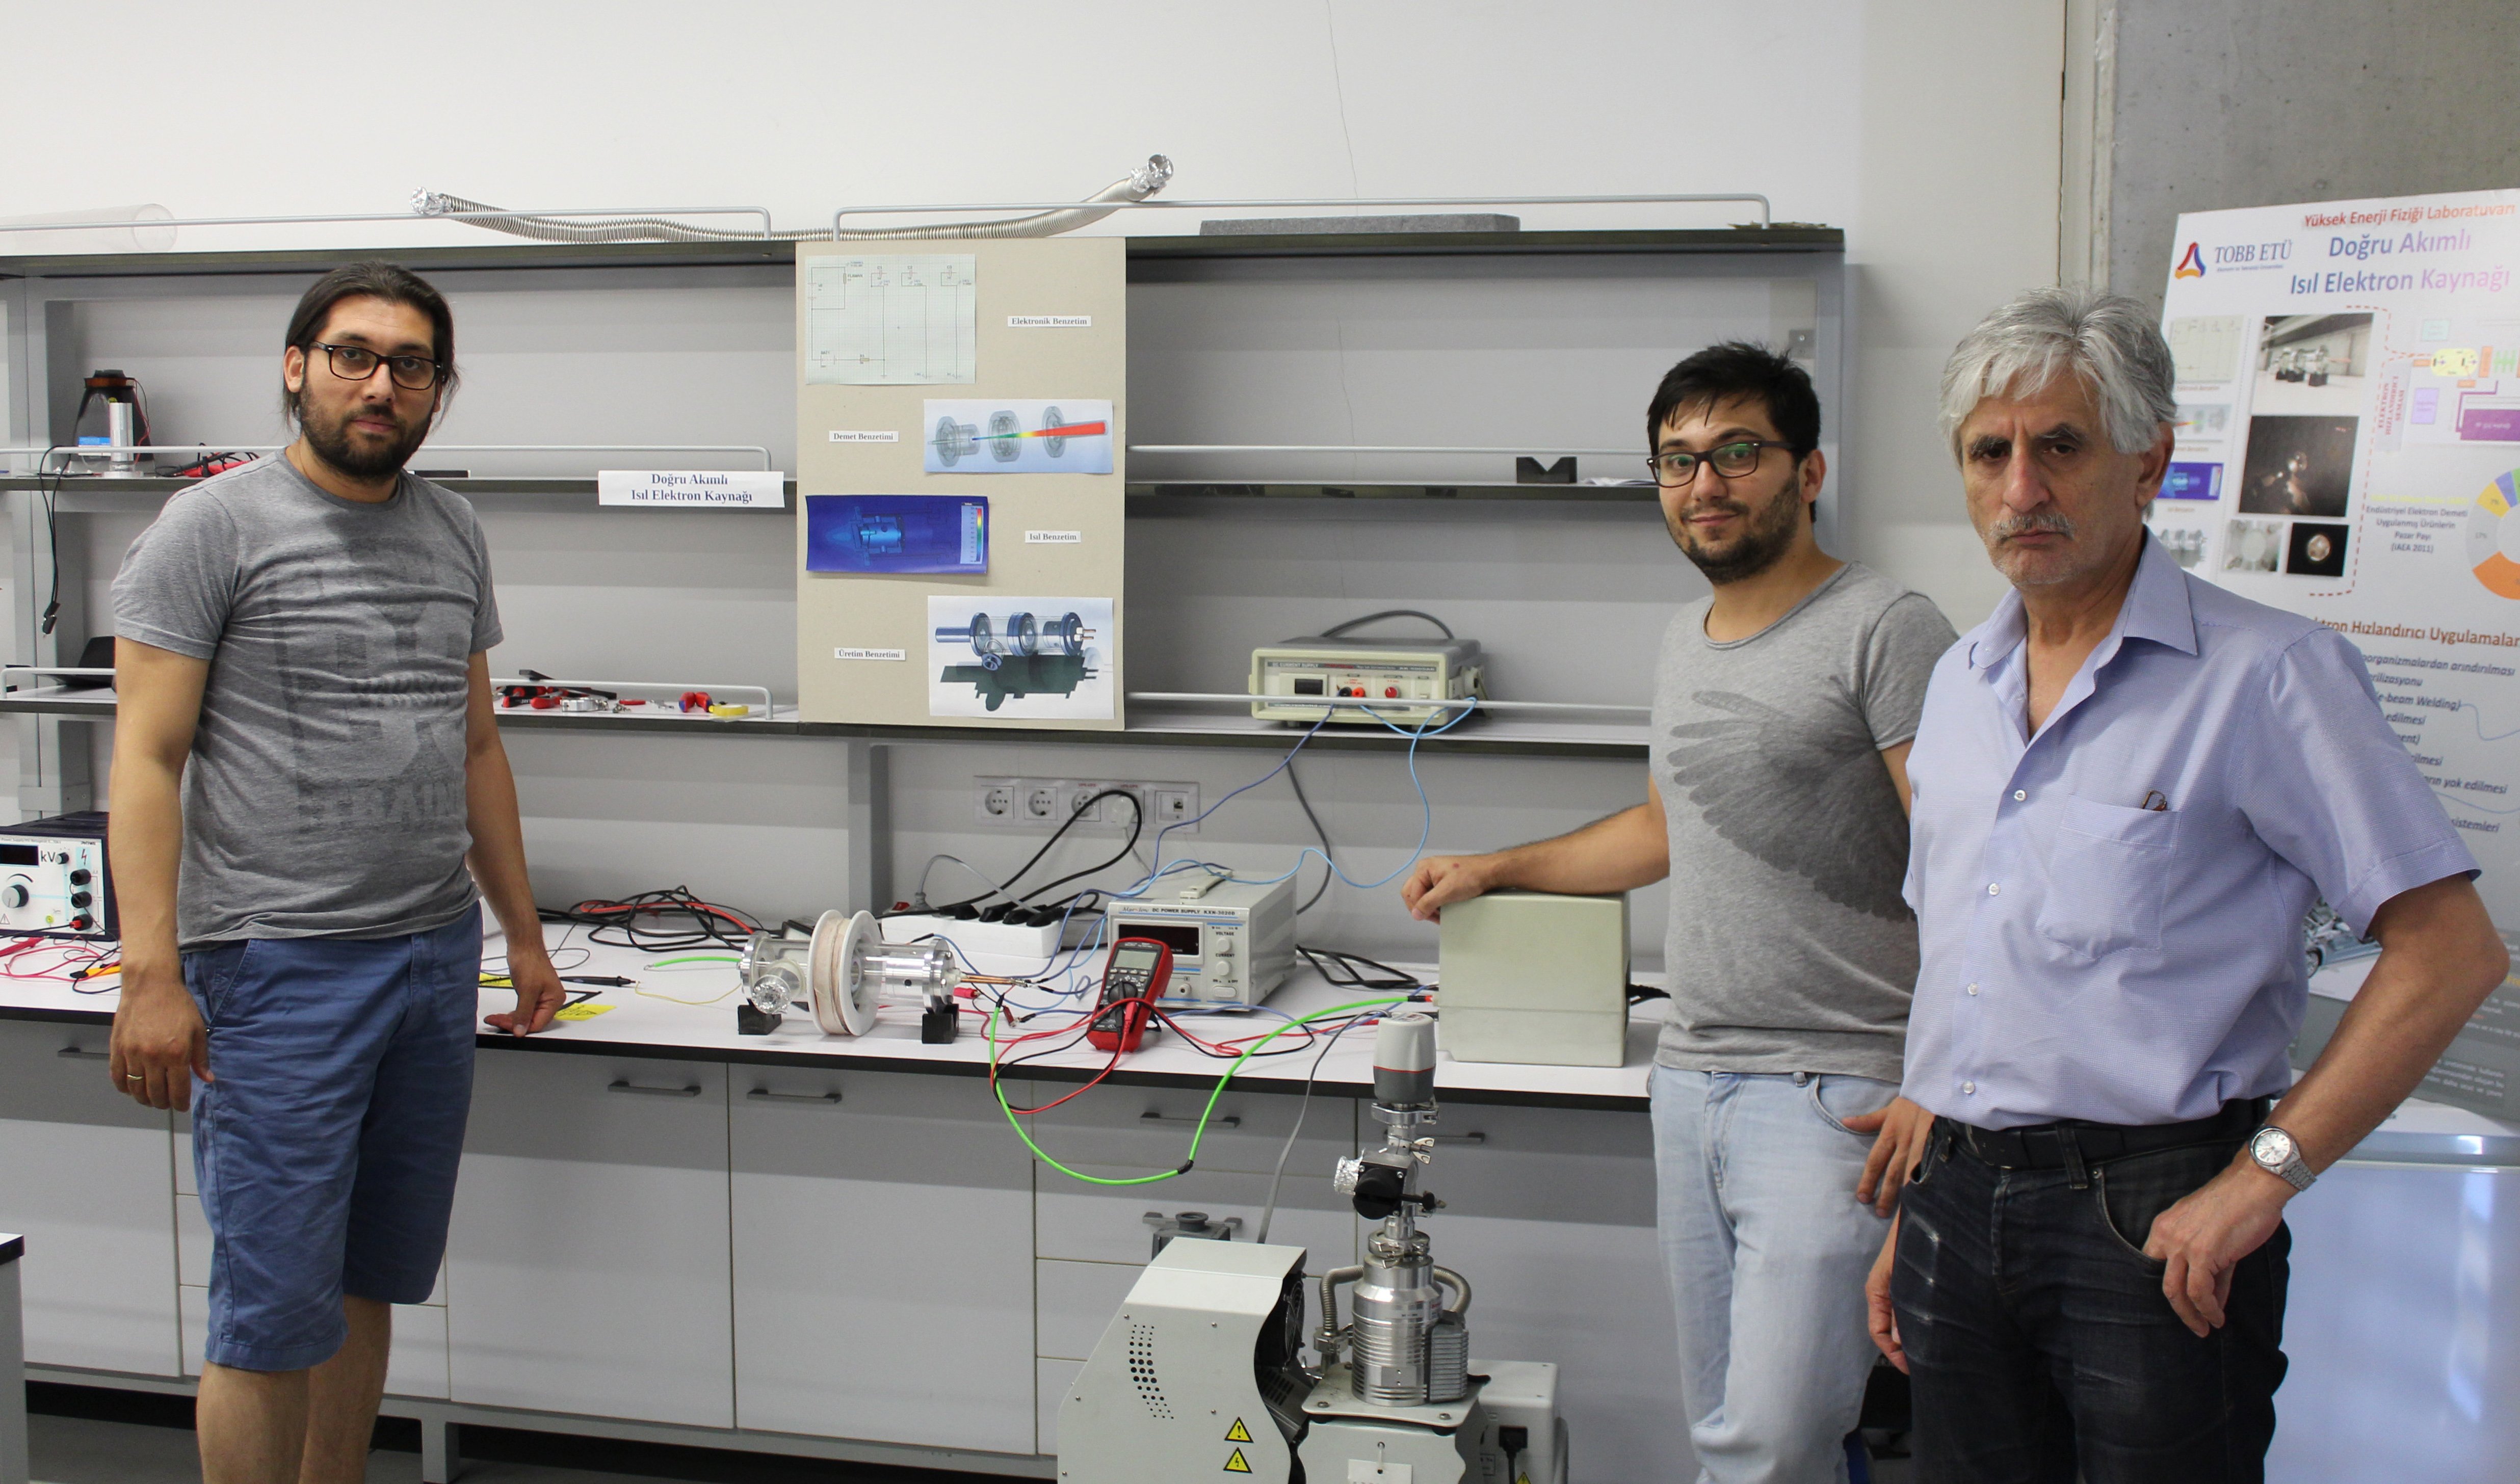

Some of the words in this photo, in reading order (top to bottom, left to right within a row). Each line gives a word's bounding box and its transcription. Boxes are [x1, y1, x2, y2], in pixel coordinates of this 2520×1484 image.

[2305, 212, 2347, 227] Yüksek
[2350, 209, 2387, 225] Enerji
[2215, 244, 2255, 263] TOBB
[2260, 239, 2293, 260] ETÜ
[2329, 233, 2393, 260] Doğru
[2399, 229, 2472, 253] Akımlı
[2291, 273, 2319, 294] Isıl
[2325, 270, 2413, 293] Elektron
[2421, 265, 2510, 294] Kaynağı
[1012, 317, 1051, 325] Elektronik
[1053, 317, 1087, 325] Benzetim
[651, 473, 686, 486] Doğru
[689, 473, 728, 485] Akımlı
[632, 490, 648, 500] Isıl
[652, 490, 701, 501] Elektron
[704, 490, 752, 504] Kaynağı
[2352, 620, 2425, 640] Hızlandırıcı
[838, 649, 863, 657] Üretim
[41, 850, 56, 863] kV
